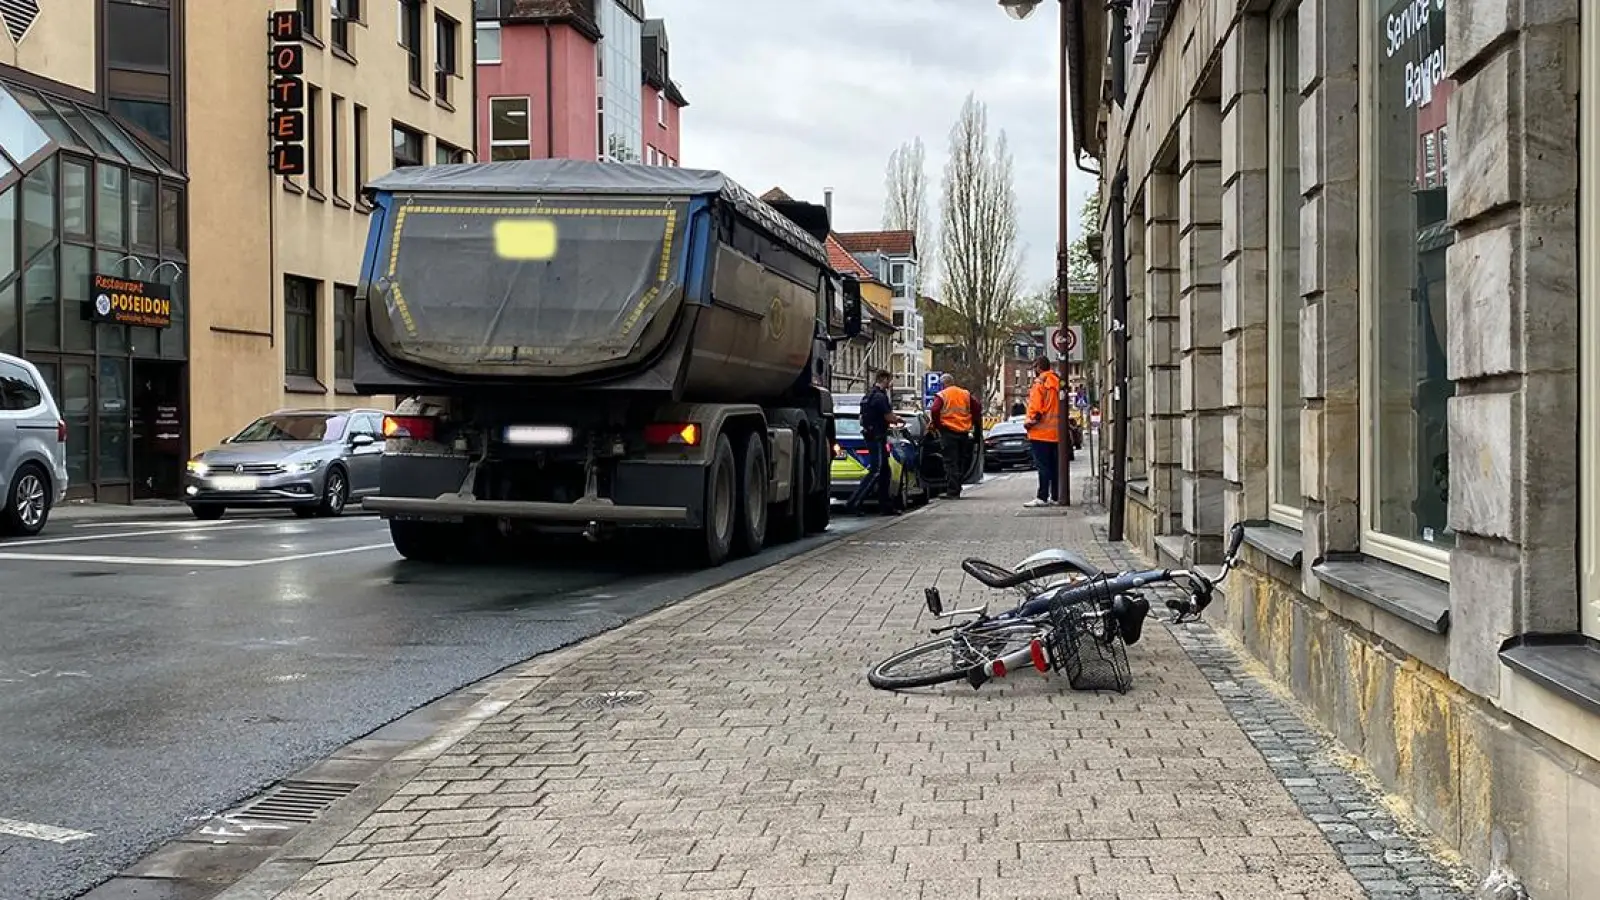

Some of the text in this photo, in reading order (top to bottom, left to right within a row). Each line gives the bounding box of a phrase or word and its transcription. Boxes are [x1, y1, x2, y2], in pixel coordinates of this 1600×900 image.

[1387, 0, 1430, 57] Service
[277, 14, 296, 170] HOTEL
[96, 275, 144, 294] Restaurant
[111, 293, 170, 315] POSEIDON
[928, 373, 940, 389] P
